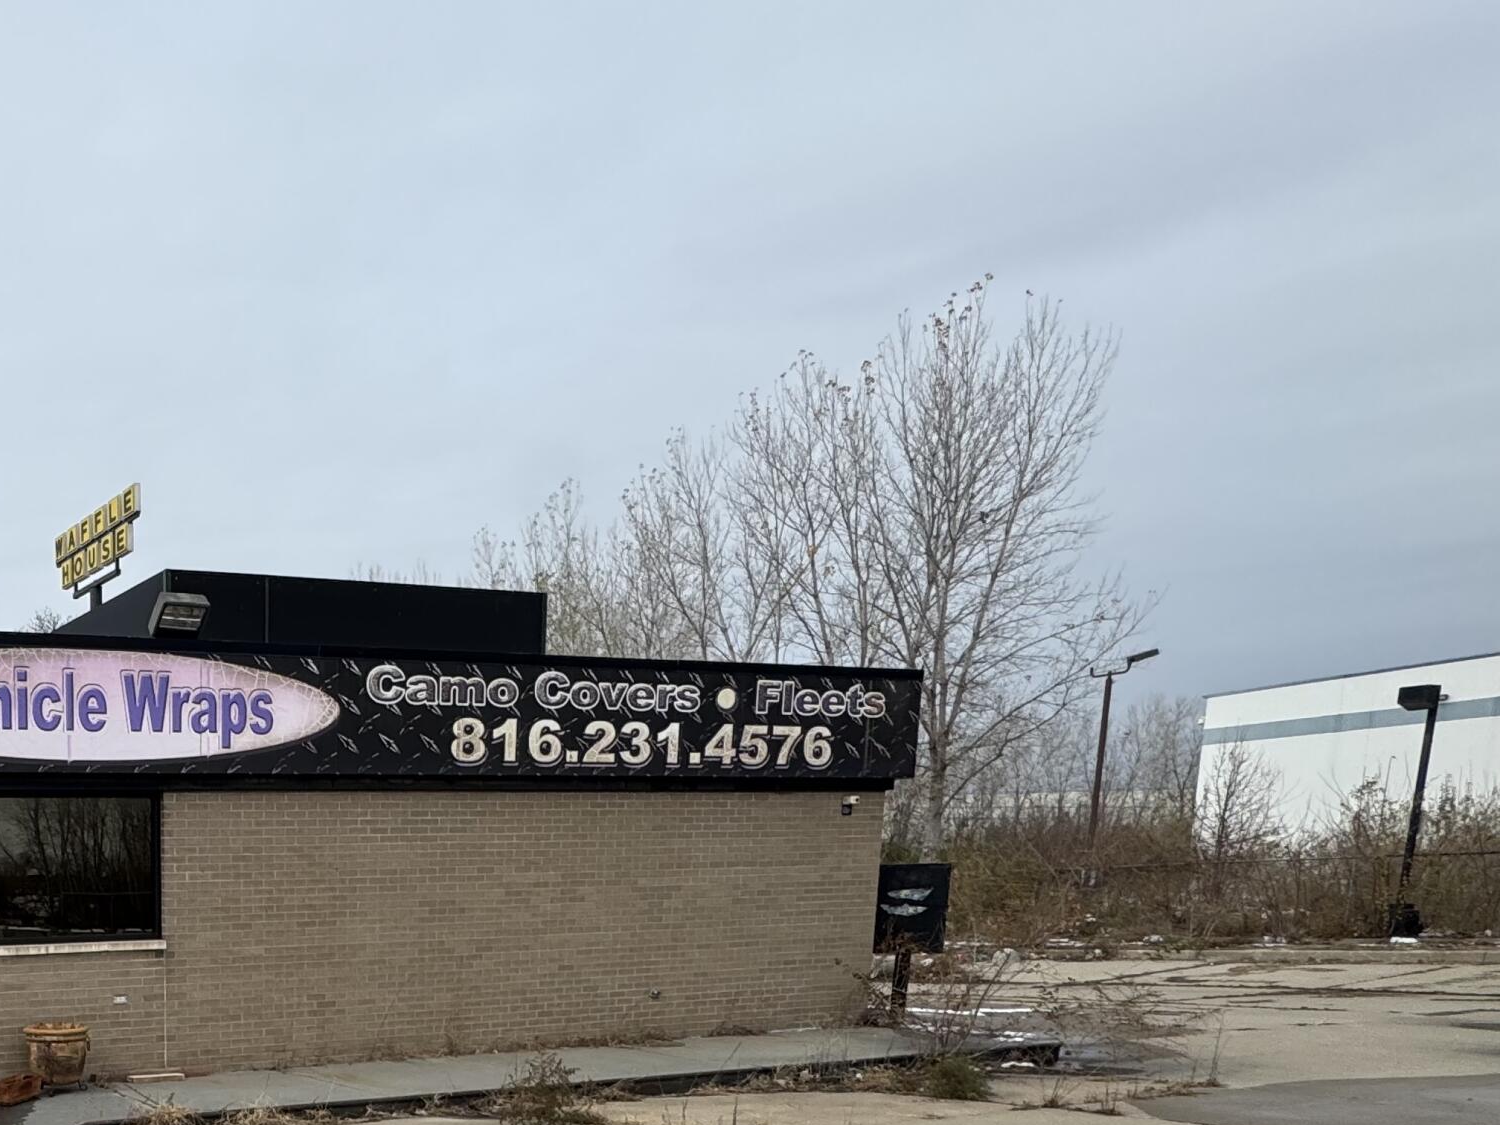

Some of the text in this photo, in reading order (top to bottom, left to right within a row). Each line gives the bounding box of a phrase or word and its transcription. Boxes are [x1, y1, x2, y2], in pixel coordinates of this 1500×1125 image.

[55, 489, 133, 560] WAFFLE
[62, 528, 125, 587] HOUSE
[120, 669, 274, 749] Wraps
[366, 664, 886, 718] Camo Covers Fleets
[450, 717, 834, 769] 816.231.4576
